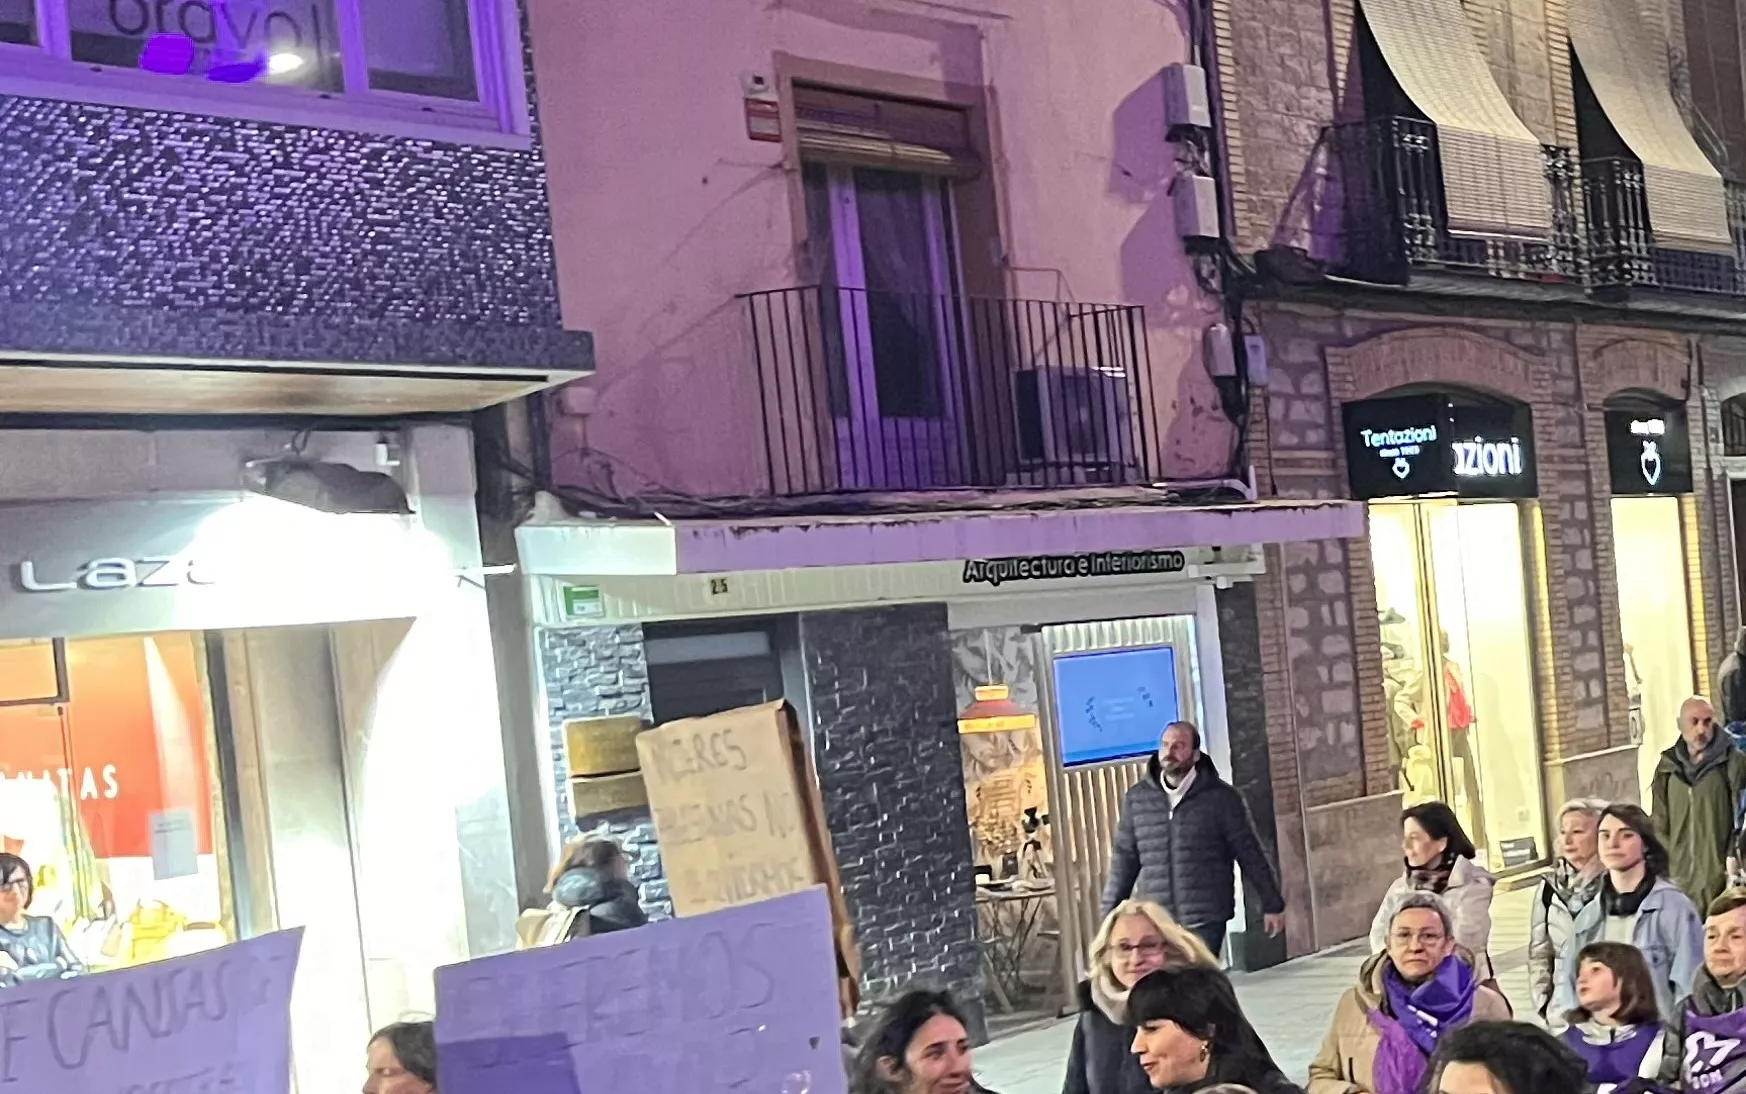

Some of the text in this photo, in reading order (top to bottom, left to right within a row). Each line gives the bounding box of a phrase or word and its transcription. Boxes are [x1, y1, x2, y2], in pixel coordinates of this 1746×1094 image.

[1360, 425, 1437, 448] Tentazioni
[964, 551, 1185, 585] Arquitectura e Interiorismo
[710, 577, 729, 596] 25
